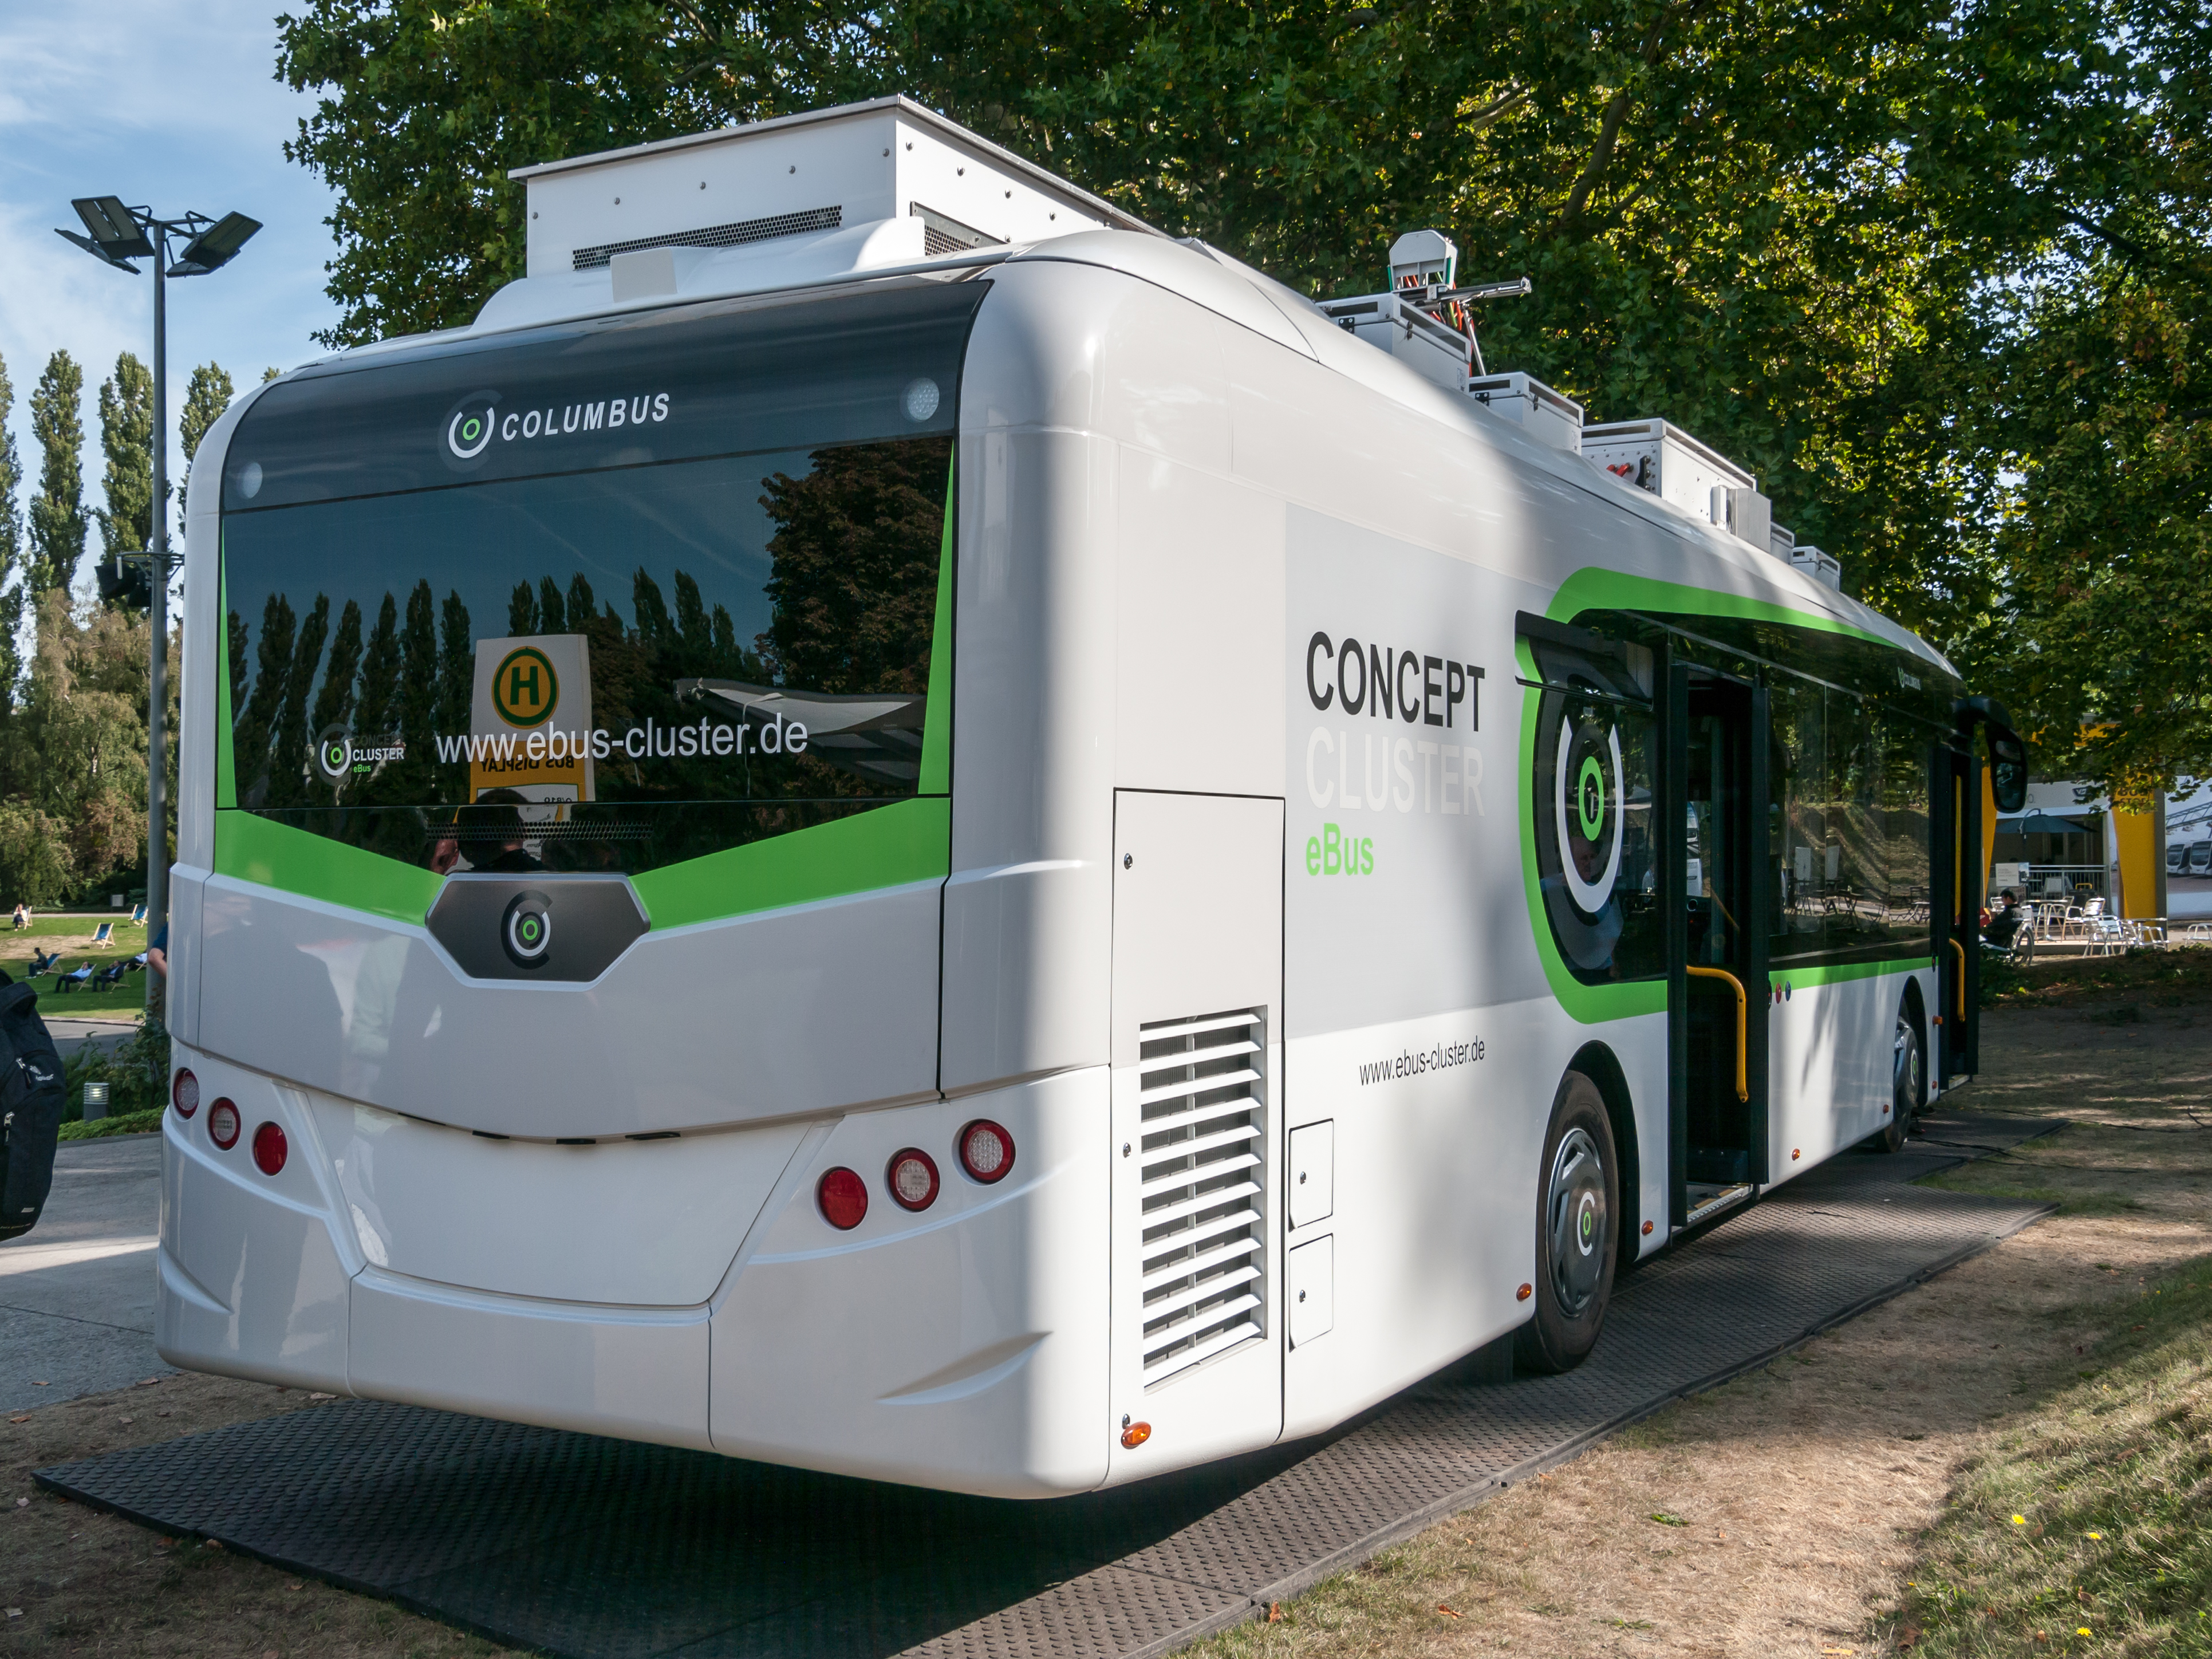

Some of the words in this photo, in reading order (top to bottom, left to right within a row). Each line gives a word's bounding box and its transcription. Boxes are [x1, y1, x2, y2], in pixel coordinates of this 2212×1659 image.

[502, 393, 669, 441] COLUMBUS
[510, 665, 540, 706] H
[1306, 631, 1485, 732] CONCEPT
[352, 747, 404, 762] CLUSTER
[436, 712, 809, 764] www.ebus-cluster.de
[353, 764, 371, 773] eBus
[1306, 726, 1485, 817] CLUSTER
[1306, 822, 1374, 876] eBus
[1359, 1035, 1485, 1086] www.ebus-cluster.de
